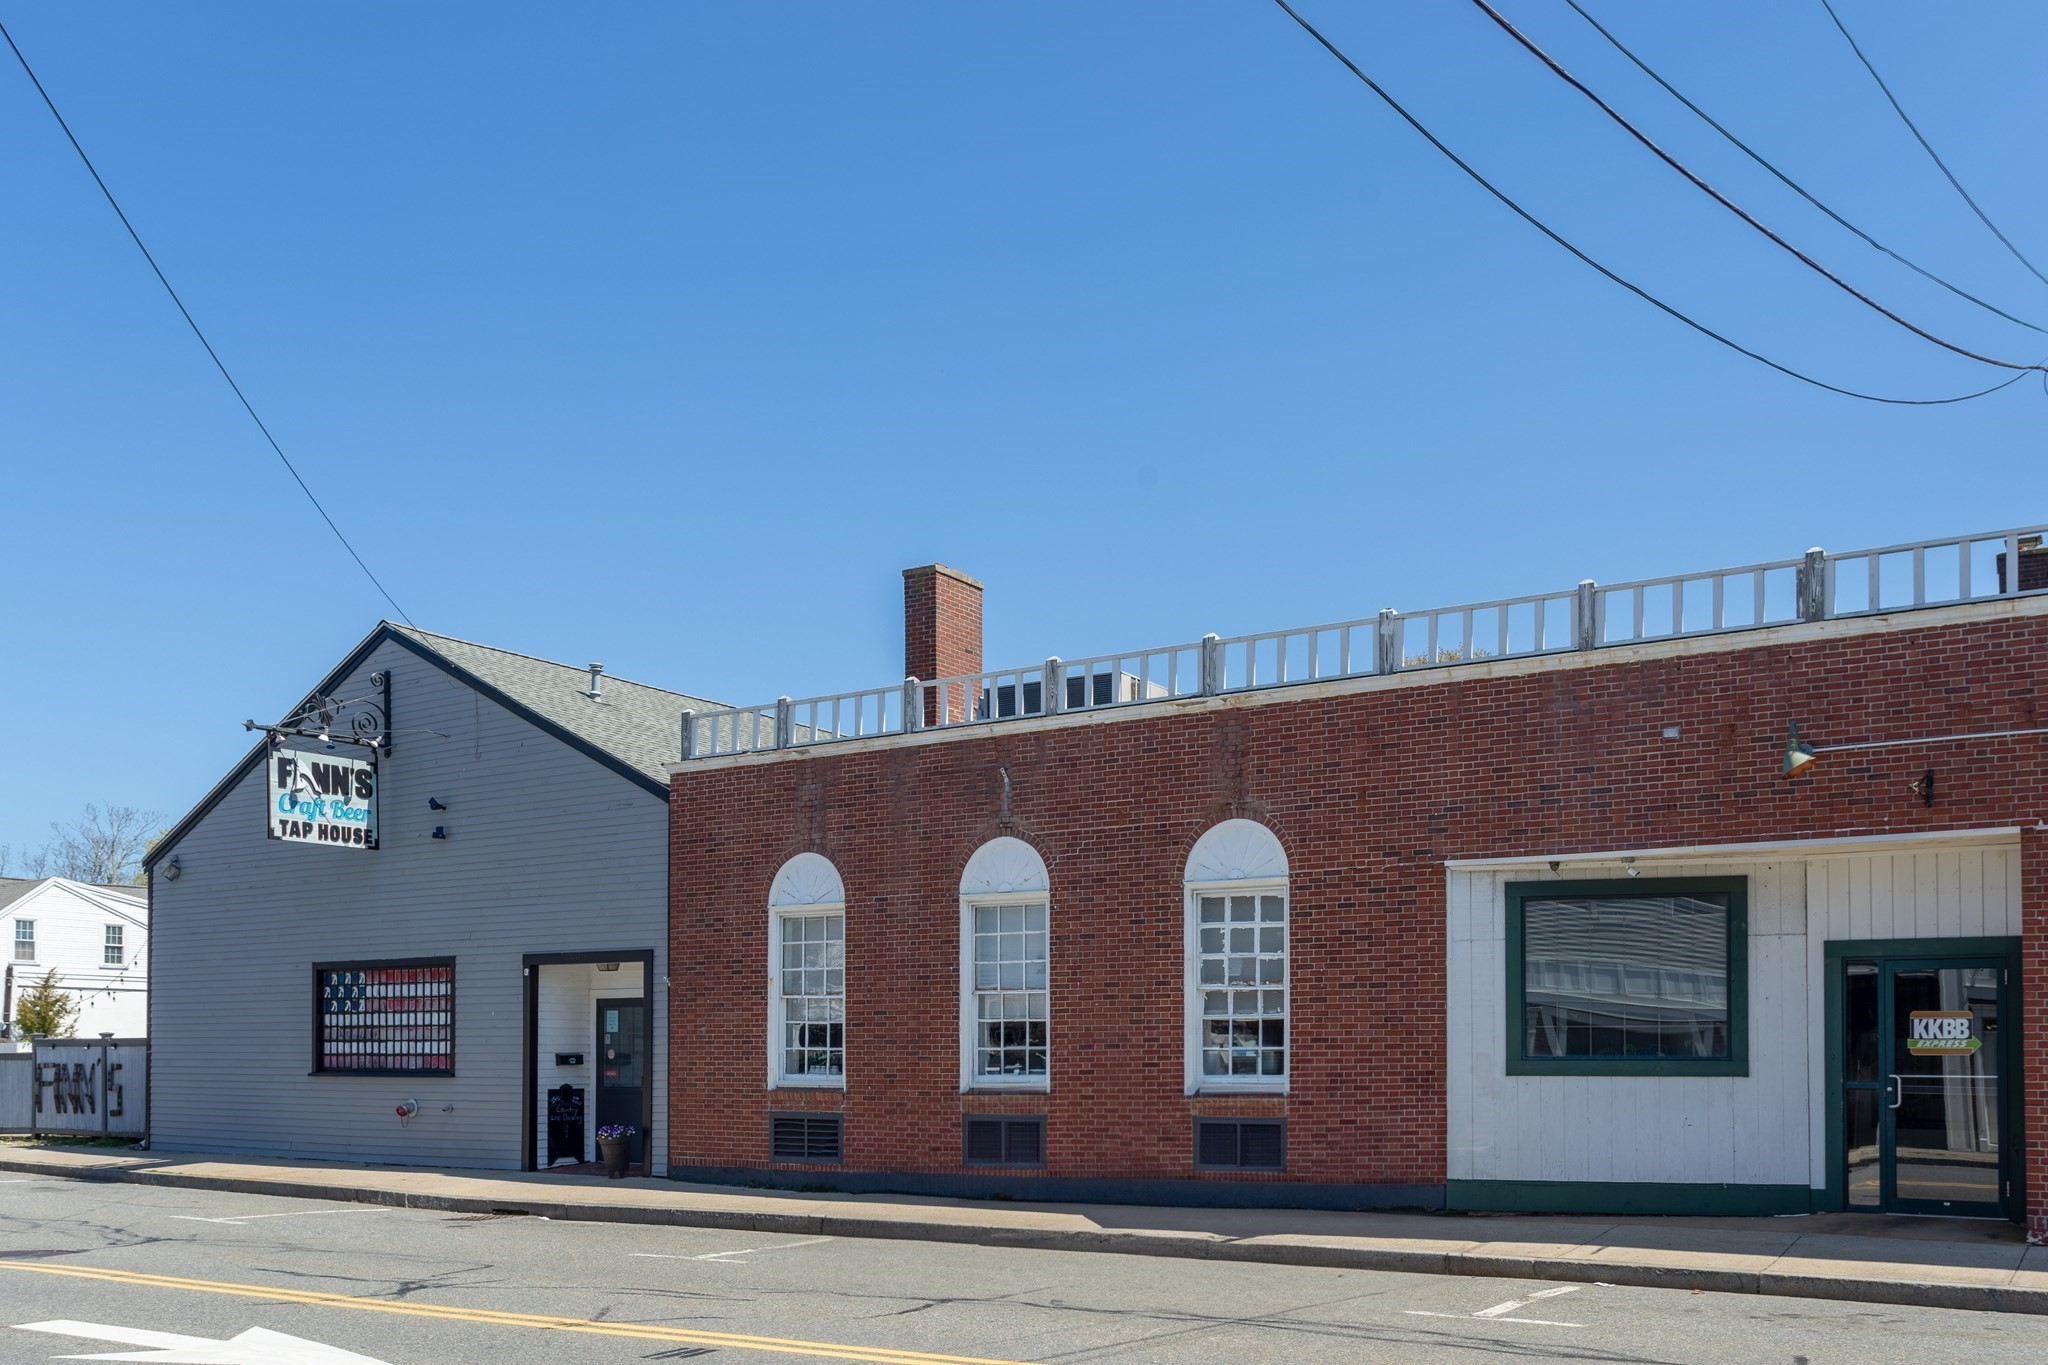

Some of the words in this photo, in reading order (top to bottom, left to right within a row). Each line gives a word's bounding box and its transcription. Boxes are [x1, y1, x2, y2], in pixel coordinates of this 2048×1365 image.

[278, 757, 373, 800] FNN'S
[278, 793, 326, 822] Craft
[330, 799, 372, 822] Beer
[279, 819, 313, 839] TAP
[318, 824, 373, 845] HOUSE
[1913, 1018, 1970, 1039] KKBB
[1916, 1040, 1967, 1048] EXPRESS
